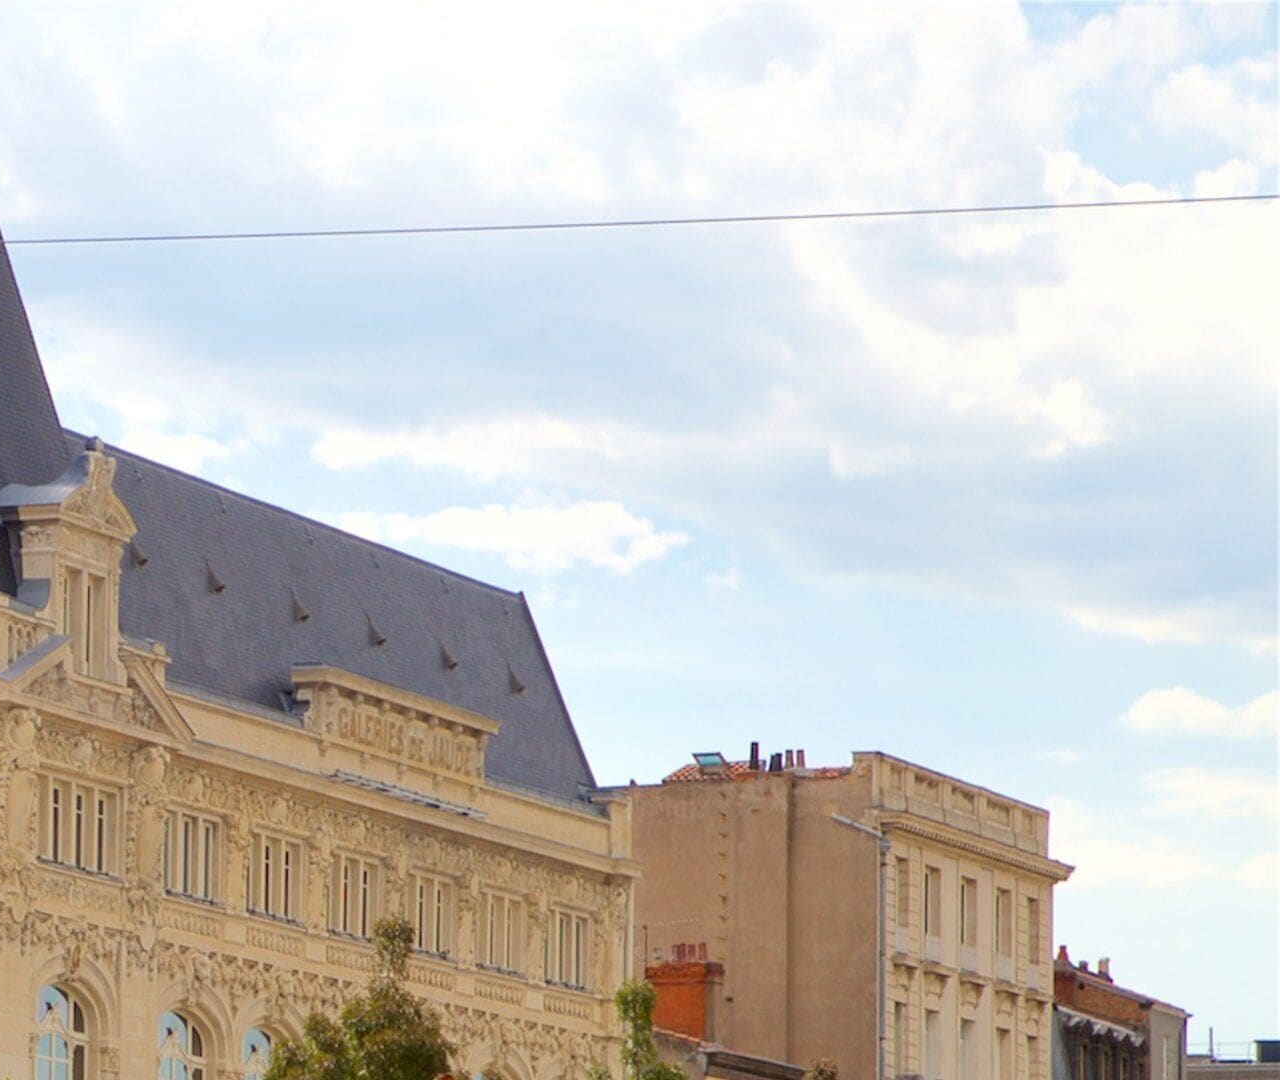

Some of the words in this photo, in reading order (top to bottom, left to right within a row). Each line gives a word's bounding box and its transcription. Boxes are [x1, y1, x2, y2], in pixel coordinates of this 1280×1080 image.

[338, 707, 406, 756] GALERIES
[408, 735, 425, 763] DE
[428, 735, 474, 777] JAUDE
